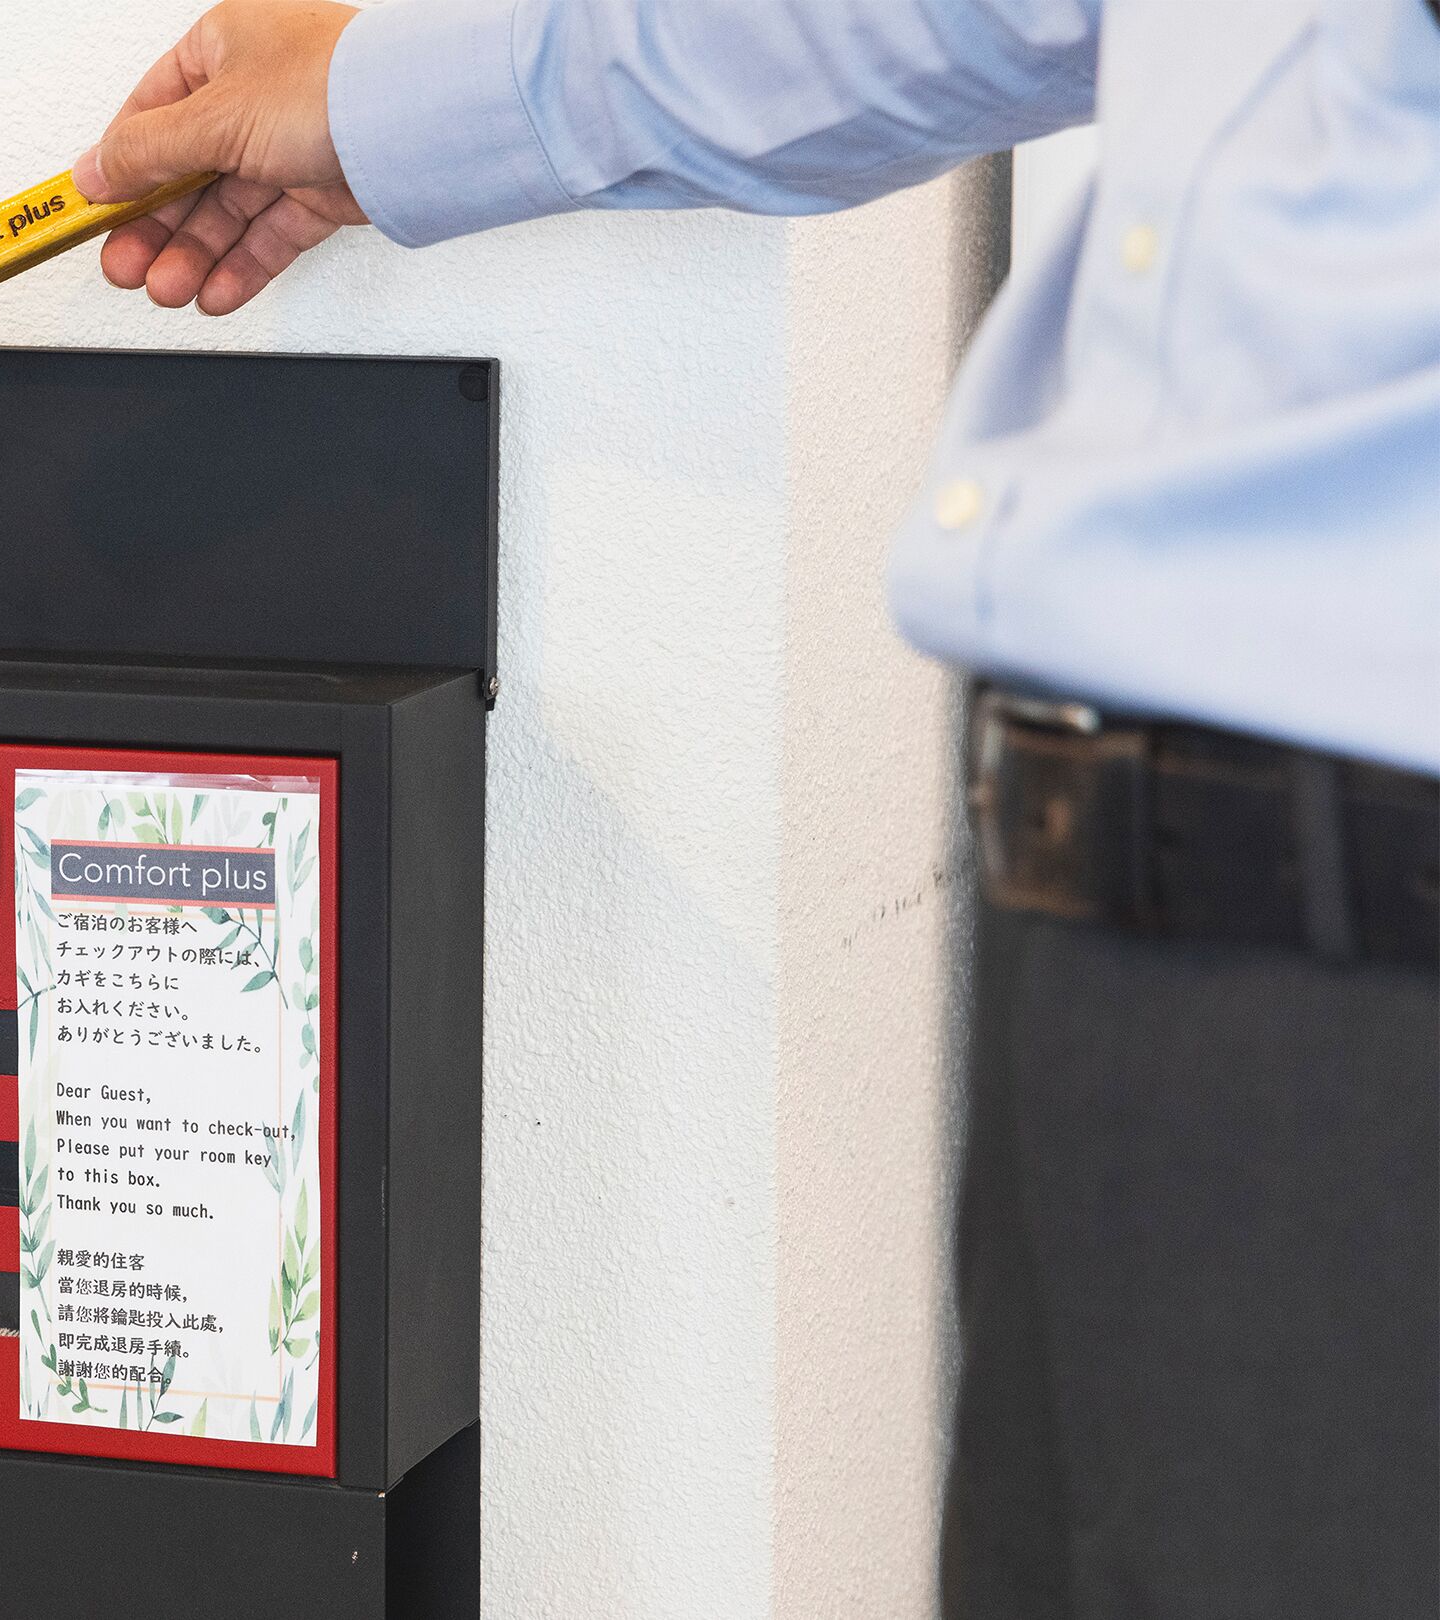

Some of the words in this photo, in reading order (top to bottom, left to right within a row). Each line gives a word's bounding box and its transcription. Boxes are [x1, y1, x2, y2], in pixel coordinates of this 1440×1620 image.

[8, 194, 66, 238] plus
[58, 852, 191, 887] Comfort
[201, 858, 267, 897] plus
[57, 912, 198, 936] ご宿泊のお客様へ
[56, 940, 261, 968] チェックアウトの際には、
[56, 969, 180, 991] カギをこちらに
[56, 997, 189, 1022] お入れください。
[56, 1025, 263, 1054] ありがとうございました。
[56, 1082, 91, 1099] Dear
[101, 1084, 151, 1105] Guest,
[56, 1110, 91, 1127] When
[101, 1116, 127, 1130] you
[136, 1118, 171, 1131] want
[182, 1119, 199, 1133] to
[208, 1120, 295, 1142] check-out,
[57, 1138, 110, 1156] Please
[119, 1144, 144, 1159] put
[154, 1147, 189, 1161] your
[200, 1151, 235, 1164] room
[245, 1150, 271, 1168] key
[57, 1167, 74, 1182] to
[84, 1168, 118, 1184] this
[128, 1170, 160, 1188] box.
[56, 1194, 101, 1212] Thank
[110, 1201, 136, 1215] you
[146, 1203, 163, 1216] so
[172, 1203, 214, 1220] much.
[57, 1248, 145, 1271] 親愛的住客
[58, 1332, 189, 1359] 即完成退房手續。
[58, 1359, 172, 1385] 謝謝您的配合。
